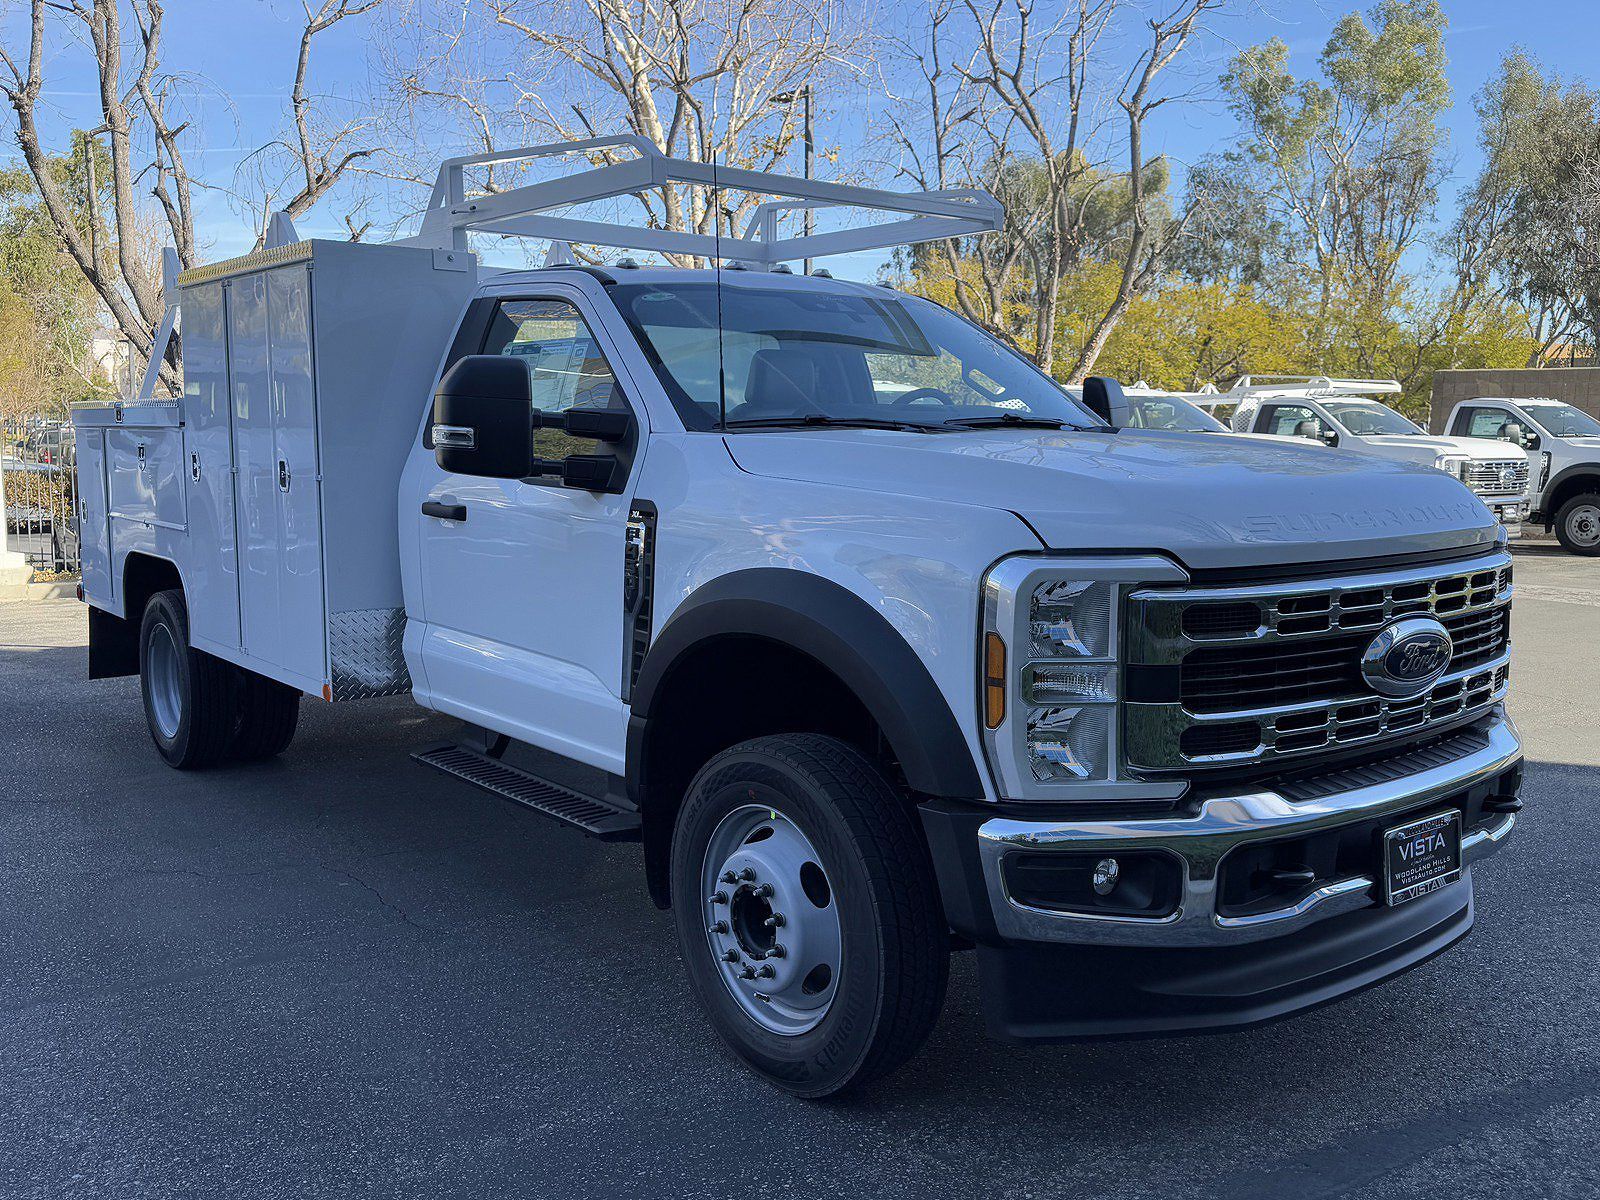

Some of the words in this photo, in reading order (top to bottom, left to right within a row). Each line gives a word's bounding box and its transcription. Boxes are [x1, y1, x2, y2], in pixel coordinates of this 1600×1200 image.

[632, 510, 643, 518] XL
[1400, 641, 1439, 674] Ford
[1399, 833, 1446, 860] VISTA
[1395, 864, 1431, 880] WOODLAND
[1432, 856, 1451, 867] HILLS
[1409, 879, 1437, 898] VISTA
